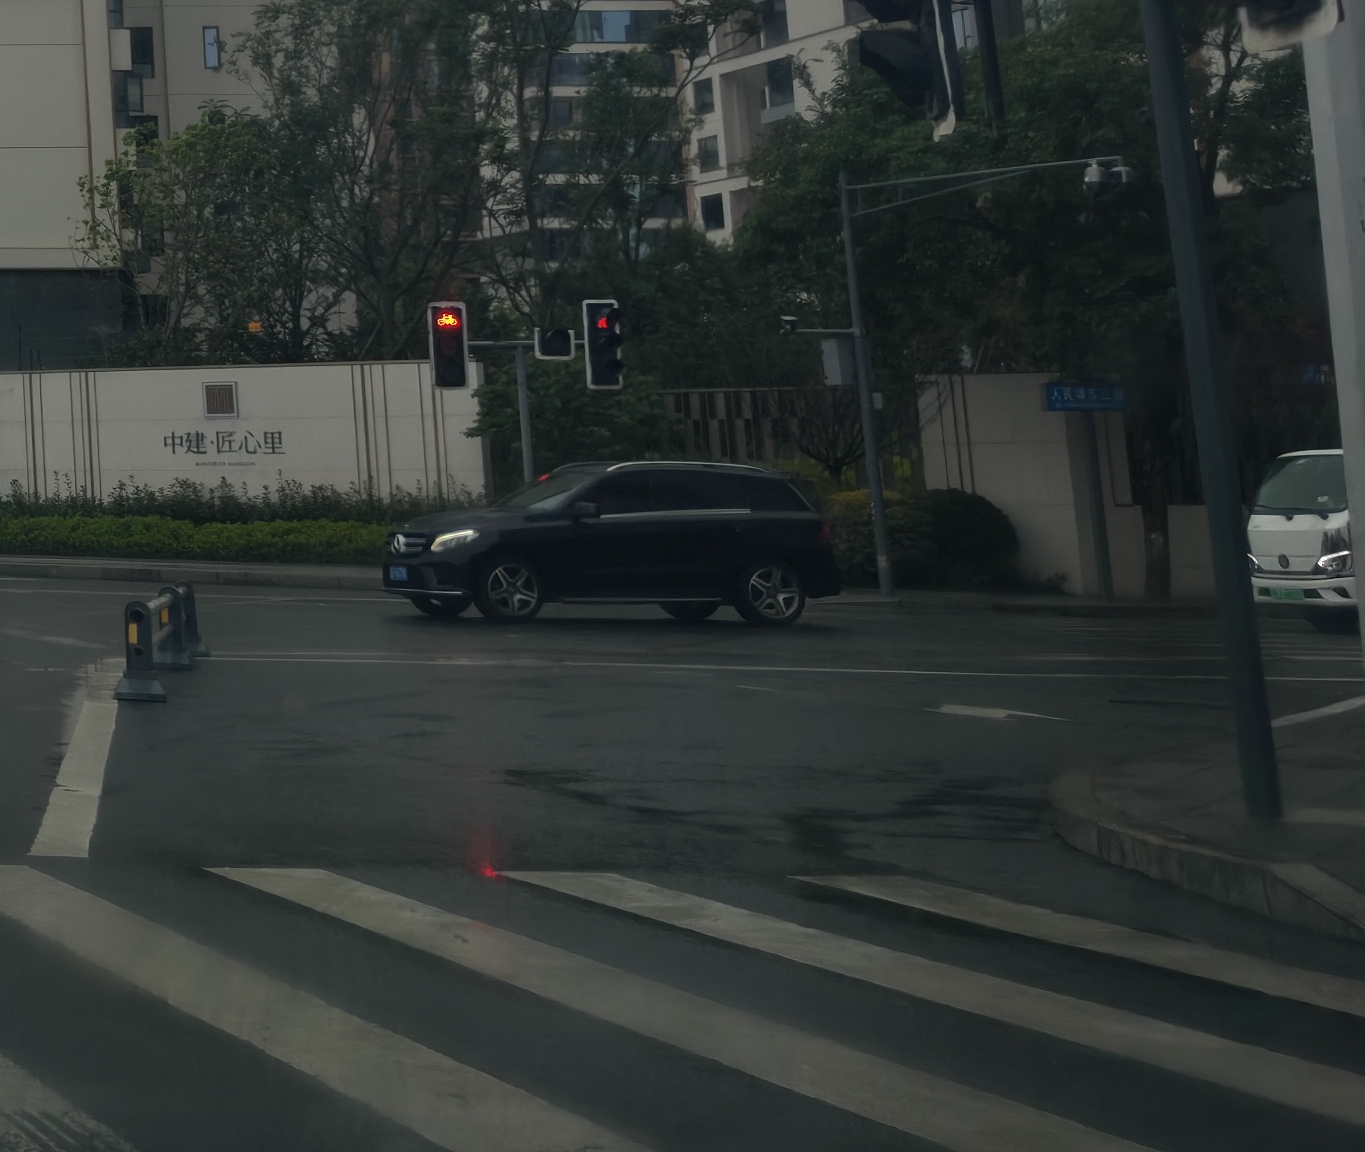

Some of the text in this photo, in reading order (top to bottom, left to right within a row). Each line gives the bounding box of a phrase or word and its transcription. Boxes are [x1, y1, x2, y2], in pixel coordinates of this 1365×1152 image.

[163, 430, 286, 455] 中建·匠心里
